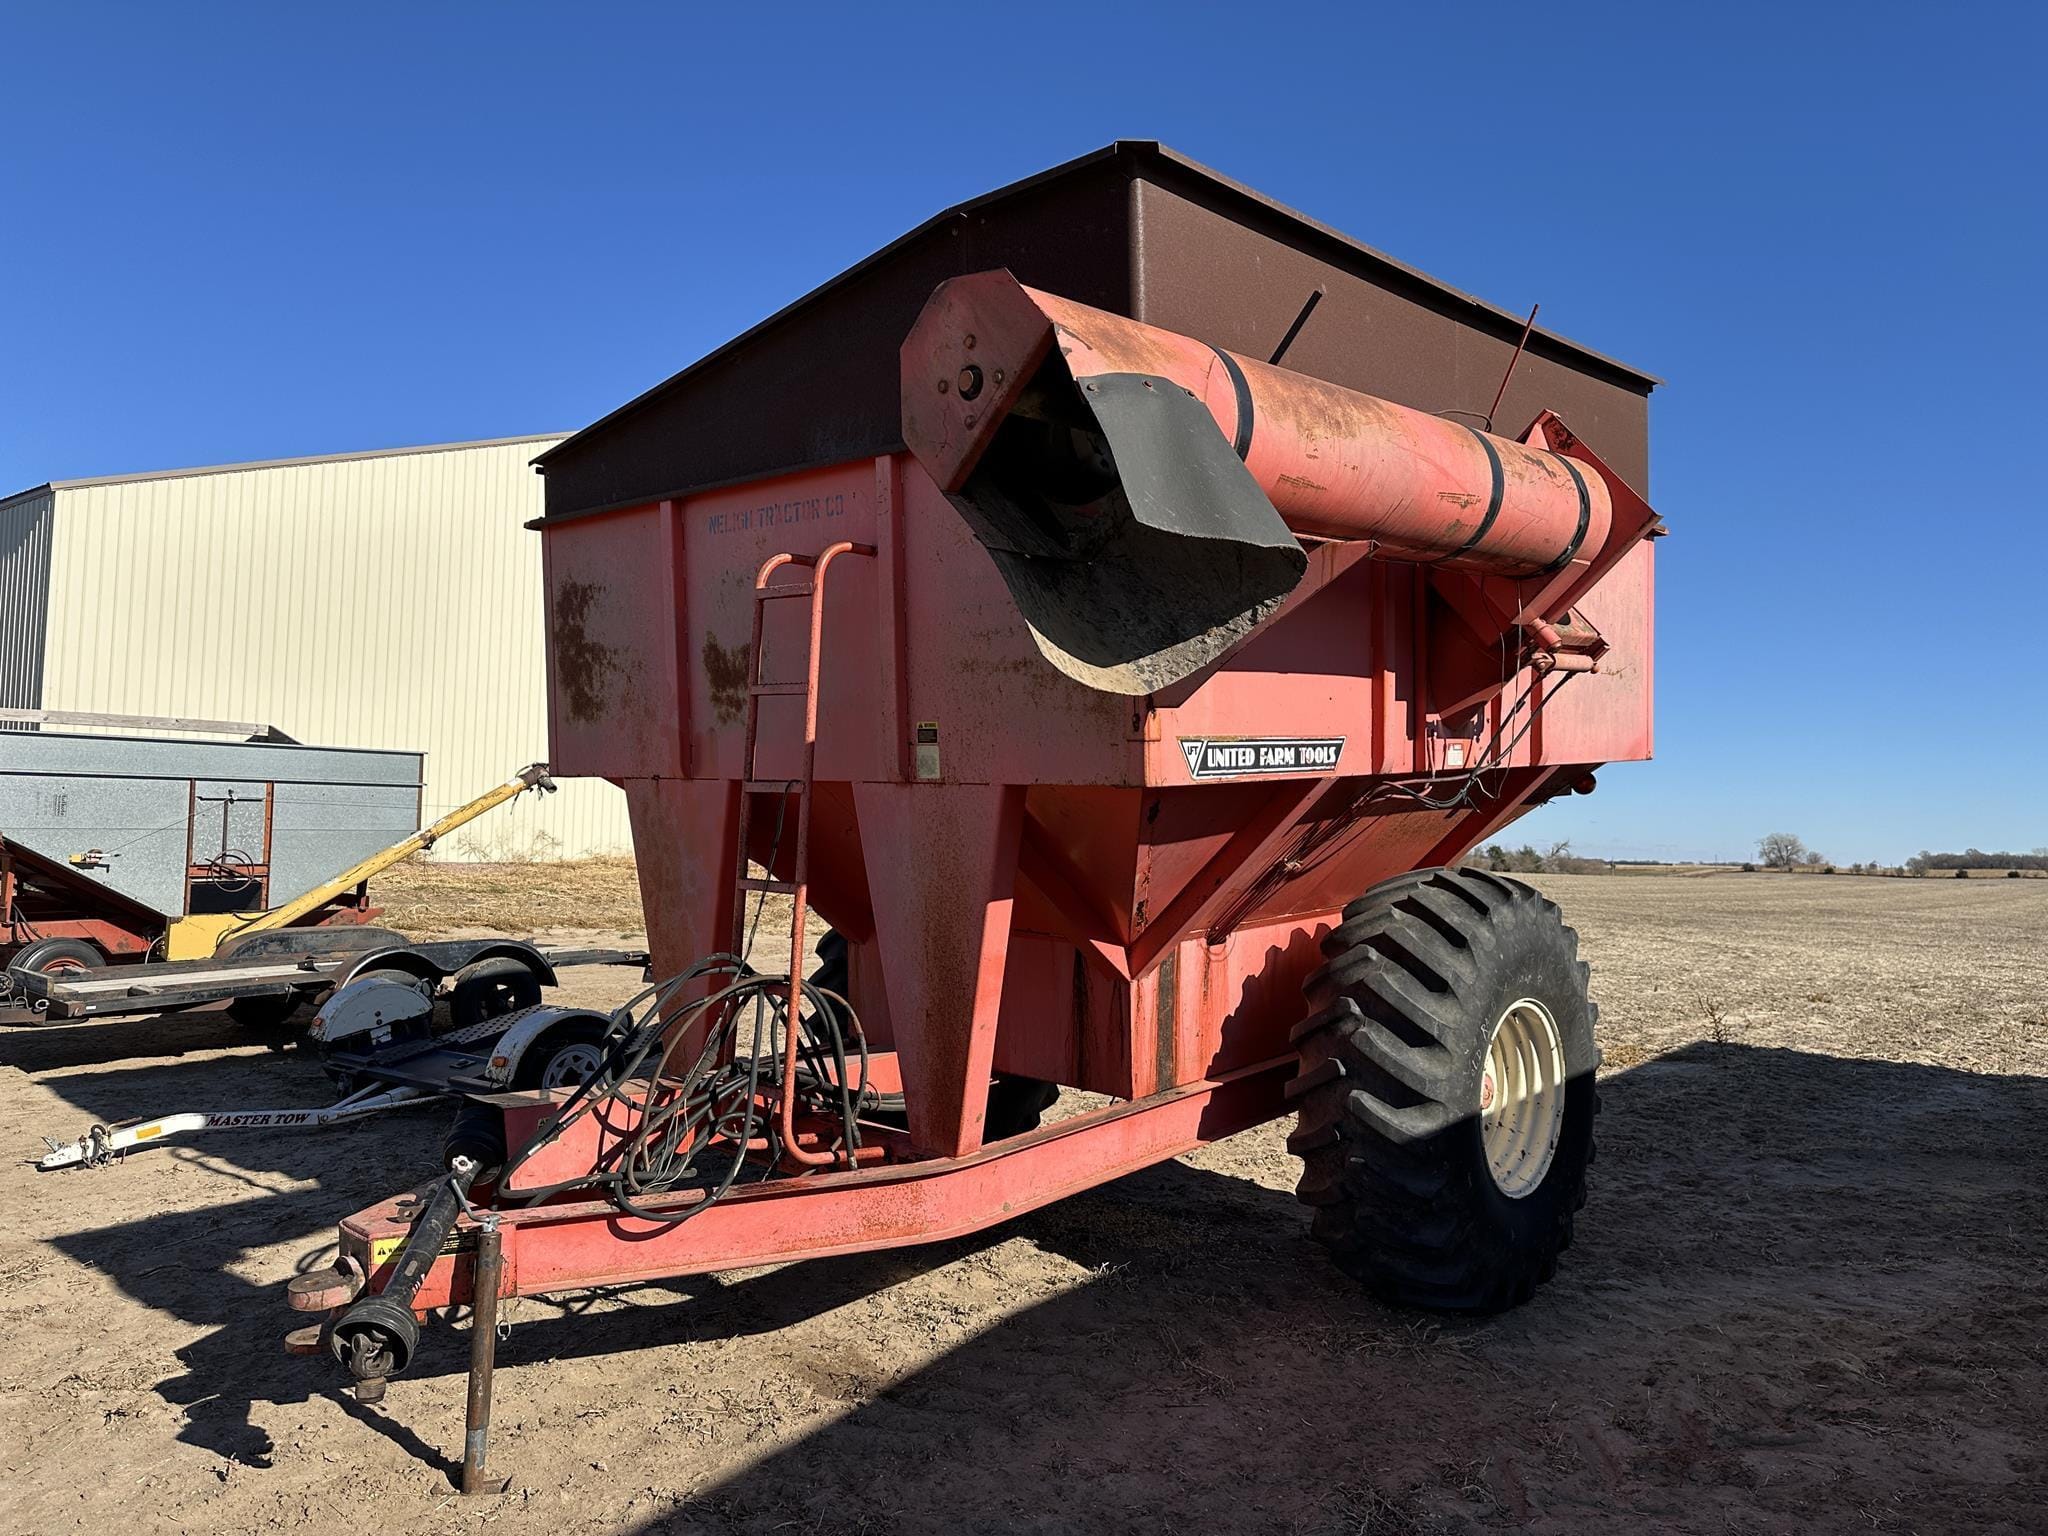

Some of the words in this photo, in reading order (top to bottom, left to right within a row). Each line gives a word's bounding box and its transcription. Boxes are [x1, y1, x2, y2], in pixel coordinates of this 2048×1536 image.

[825, 494, 844, 517] CO
[1207, 746, 1256, 768] UNITED
[1259, 746, 1295, 766] FARM
[1299, 745, 1337, 765] TOOLS
[206, 1114, 272, 1127] MASTER
[274, 1113, 311, 1125] TOW
